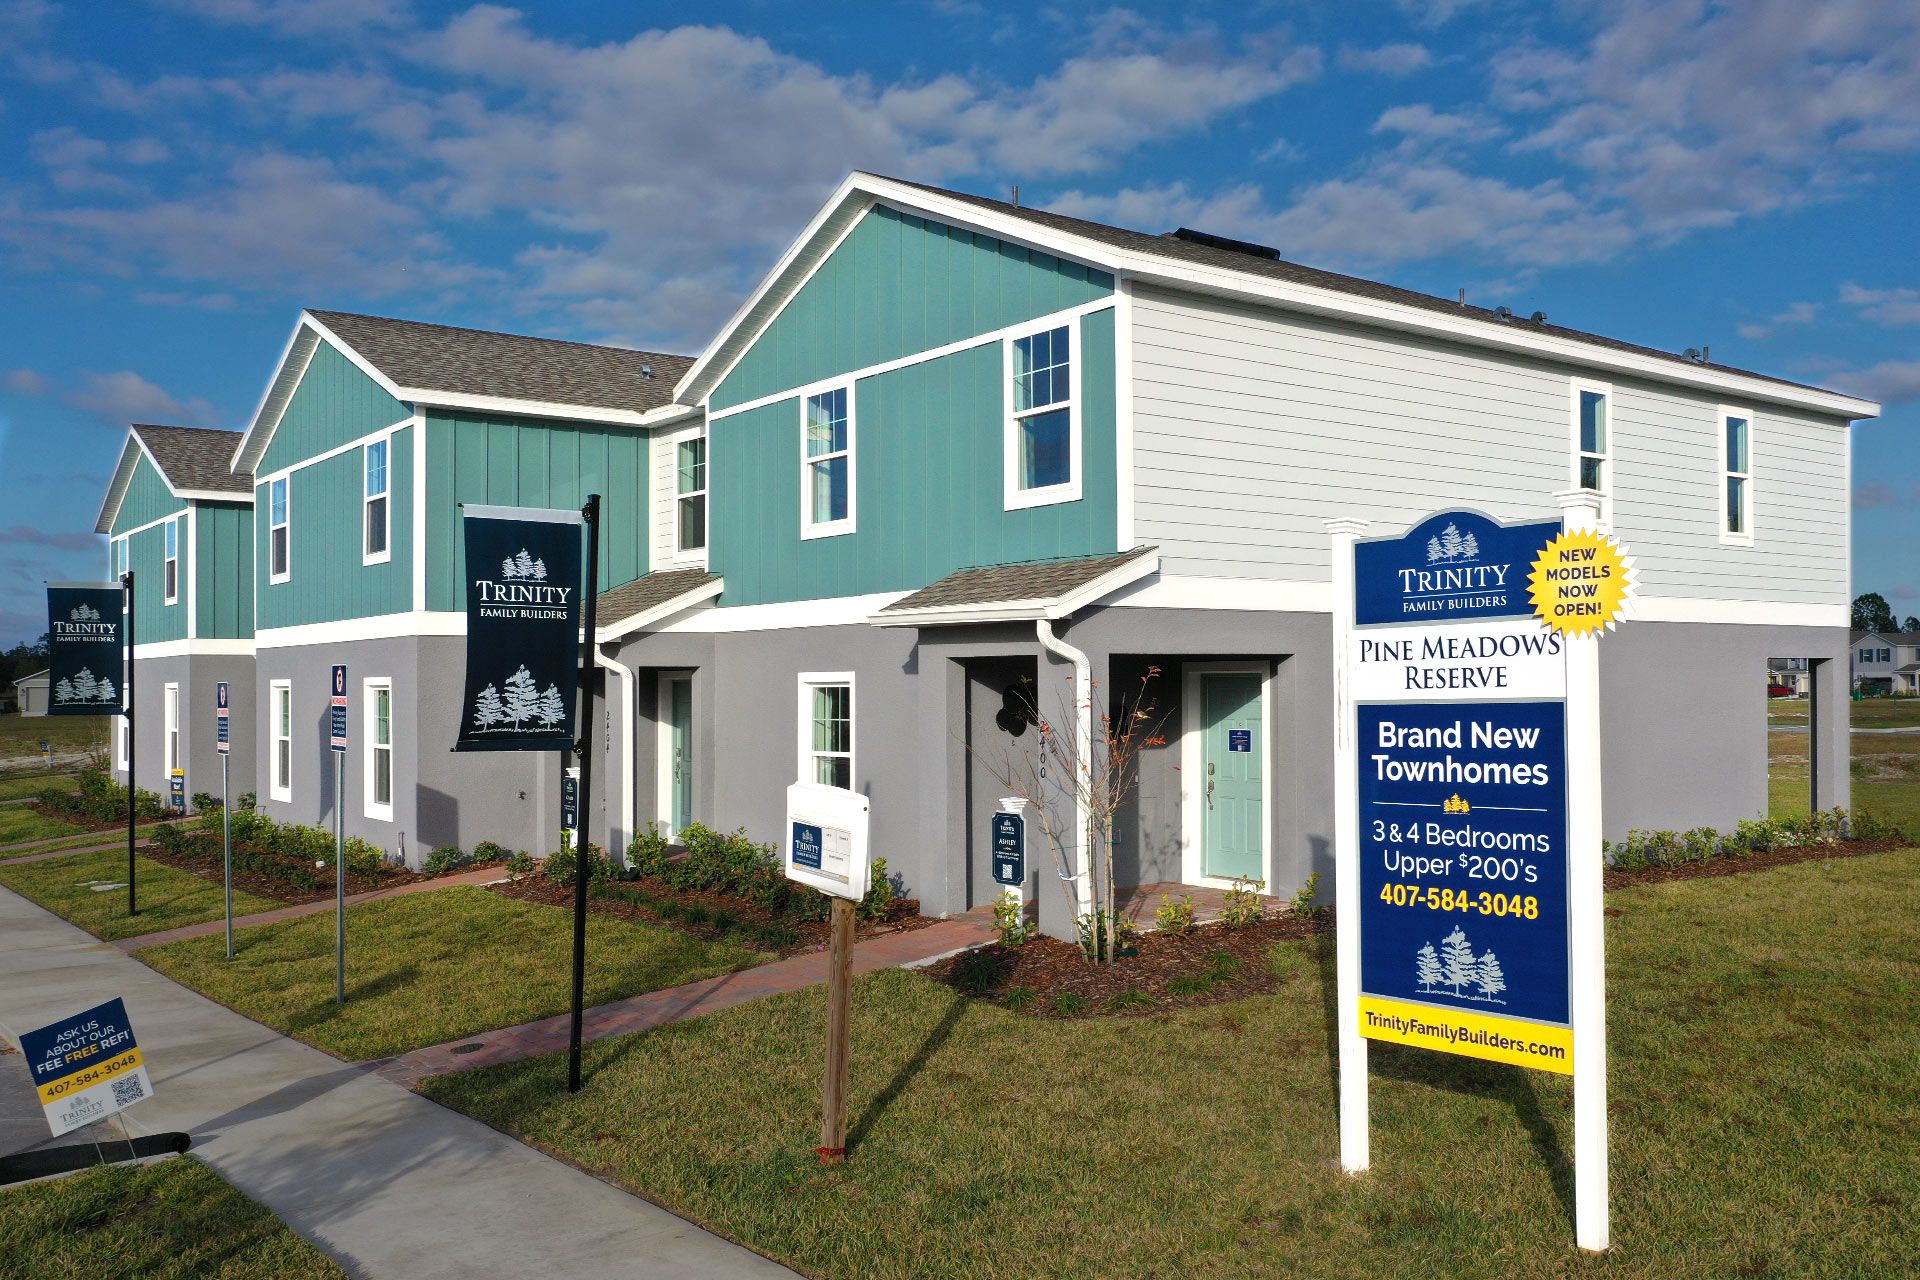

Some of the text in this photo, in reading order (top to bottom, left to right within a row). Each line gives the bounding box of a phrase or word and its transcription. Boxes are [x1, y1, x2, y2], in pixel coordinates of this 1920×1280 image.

[1559, 547, 1597, 562] NEW
[1399, 564, 1510, 593] TRINITY
[1546, 565, 1610, 581] MODELS
[475, 580, 571, 604] TRINITY
[1558, 584, 1598, 599] NOW
[480, 608, 567, 620] FAMILY BUILDERS
[1403, 595, 1507, 613] FAMILY BUILDERS
[1554, 601, 1602, 616] OPEN!
[53, 621, 117, 634] TRINITY
[1360, 632, 1560, 662] PINE MEADOWS
[1404, 665, 1508, 690] RESERVE
[1378, 720, 1540, 749] Brand New
[1371, 754, 1549, 785] Townhomes
[795, 840, 819, 853] TRINITY
[998, 838, 1016, 846] ASHLEY
[1373, 820, 1550, 852] 3 & 4 Bedrooms
[1384, 850, 1538, 883] Upper $200's
[1380, 883, 1539, 920] 407-584-3048
[46, 1025, 115, 1058] ABOUT OUR
[56, 1020, 99, 1043] ASK US
[1365, 1011, 1565, 1060] TrinityFamilyBuilders.com
[37, 1058, 63, 1074] FEE
[65, 1043, 100, 1064] FREE
[47, 1055, 136, 1096] 407-584-3048
[60, 1100, 103, 1122] TRINITY
